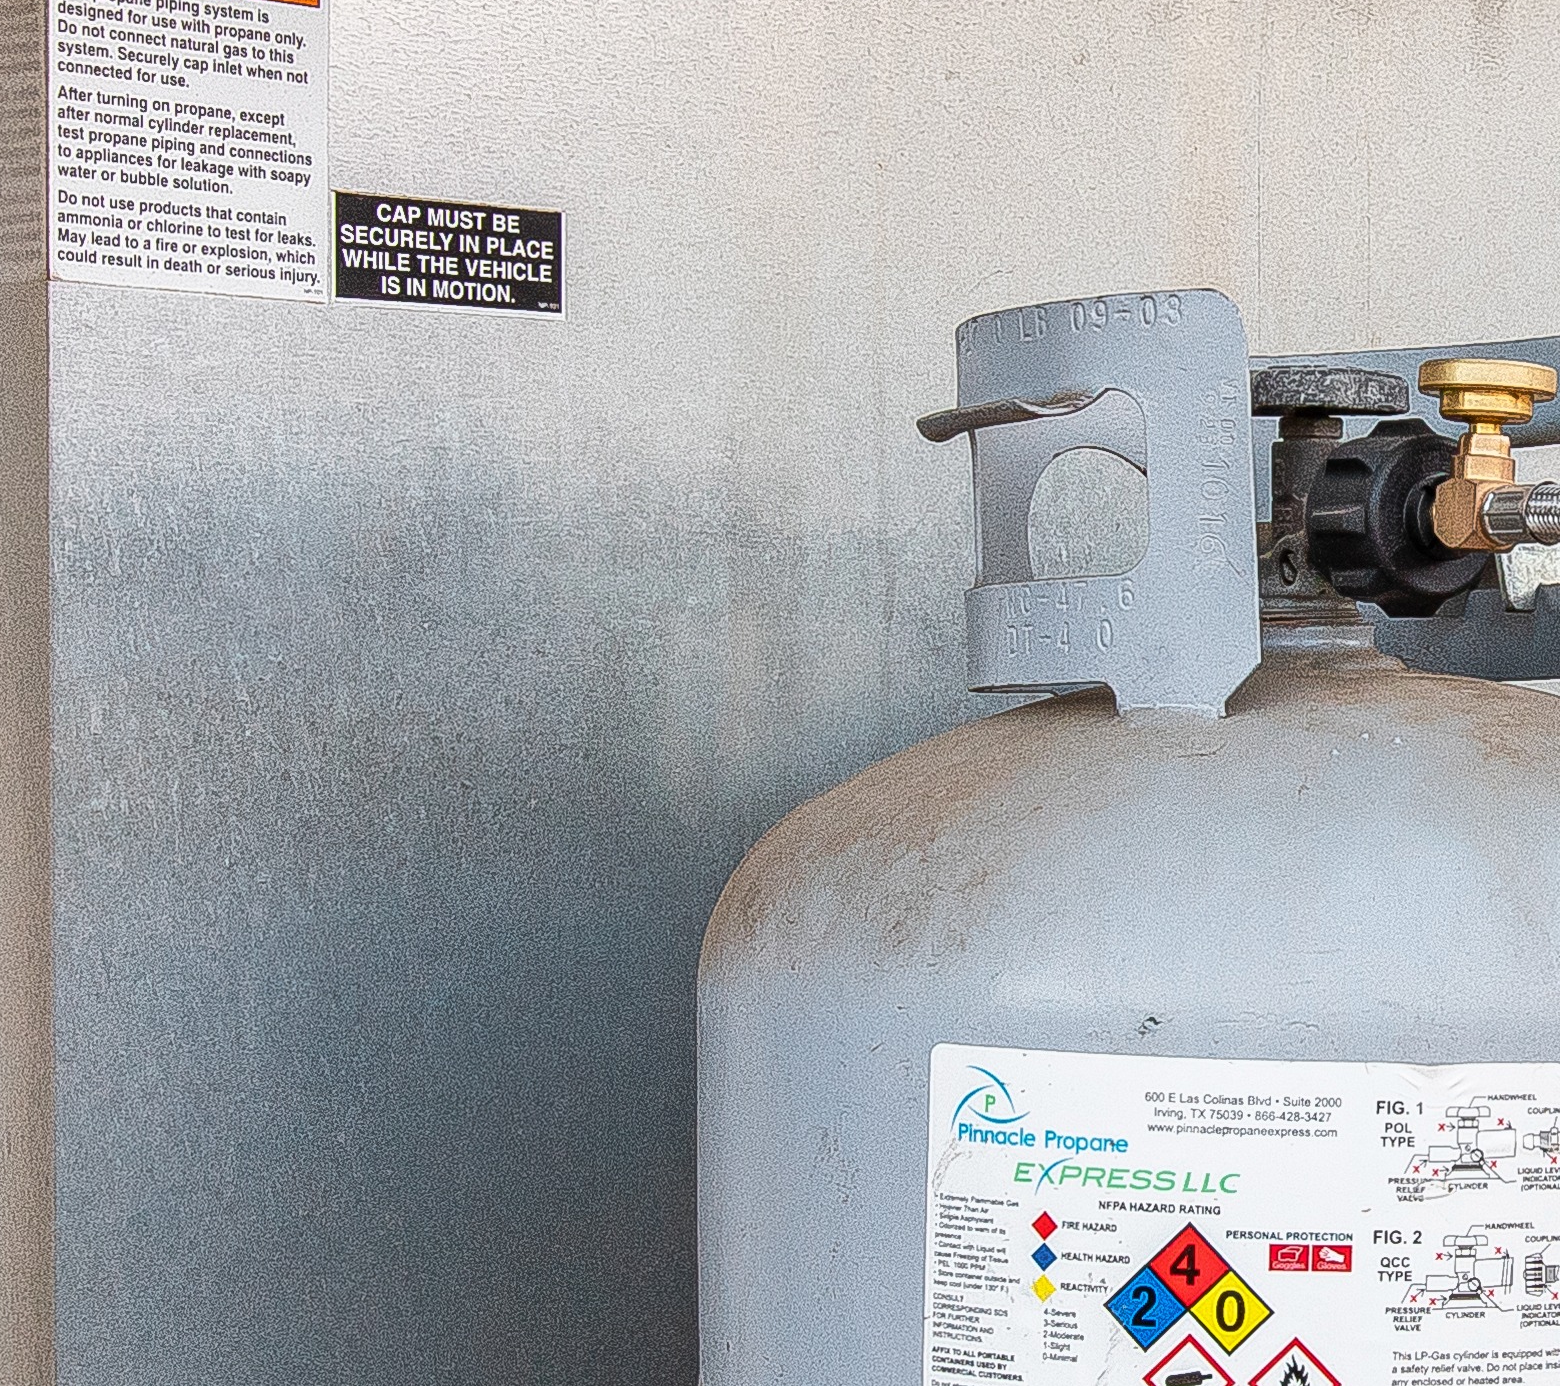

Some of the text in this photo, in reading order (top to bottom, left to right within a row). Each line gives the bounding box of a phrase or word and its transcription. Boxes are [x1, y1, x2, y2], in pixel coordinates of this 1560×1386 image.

[203, 3, 254, 22] system
[256, 7, 270, 24] is
[56, 59, 190, 88] connected for use.
[56, 123, 313, 167] test propane piping and connections
[56, 164, 233, 195] water or bubble solution.
[377, 203, 519, 233] CAP MUST BE
[341, 224, 553, 259] SECURELY IN PLACE
[56, 248, 321, 287] could result in death or serious injury.
[342, 248, 552, 282] WHILE THE VEHICLE
[382, 276, 515, 303] IS IN MOTION.
[985, 1094, 996, 1112] P
[1144, 1091, 1342, 1108] 600 E Las Colinas Blvd Suite 2000
[1376, 1100, 1422, 1115] FIG. 1
[1154, 1107, 1331, 1122] Irving, TX 75039 866-428-3427
[1385, 1122, 1412, 1134] POL
[958, 1122, 1129, 1154] Pinnacle Propane
[1380, 1136, 1415, 1147] TYPE
[1013, 1162, 1240, 1193] EXPRESS LLC
[1098, 1200, 1221, 1215] NFPA HAZARD RATING
[1061, 1220, 1117, 1233] FIRE HAZARD
[1226, 1230, 1353, 1241] PERSONAL PROTECTION
[1373, 1230, 1422, 1244] FIG. 2
[1060, 1251, 1130, 1264] HEALTH HAZARD
[1170, 1244, 1200, 1286] 4
[1380, 1256, 1410, 1268] QCC
[1377, 1270, 1412, 1282] TYPE
[1060, 1282, 1108, 1293] REACTIVITY
[1131, 1286, 1245, 1332] 2 0
[1384, 1306, 1431, 1314] PRESSURE
[1392, 1315, 1423, 1323] RELIEF
